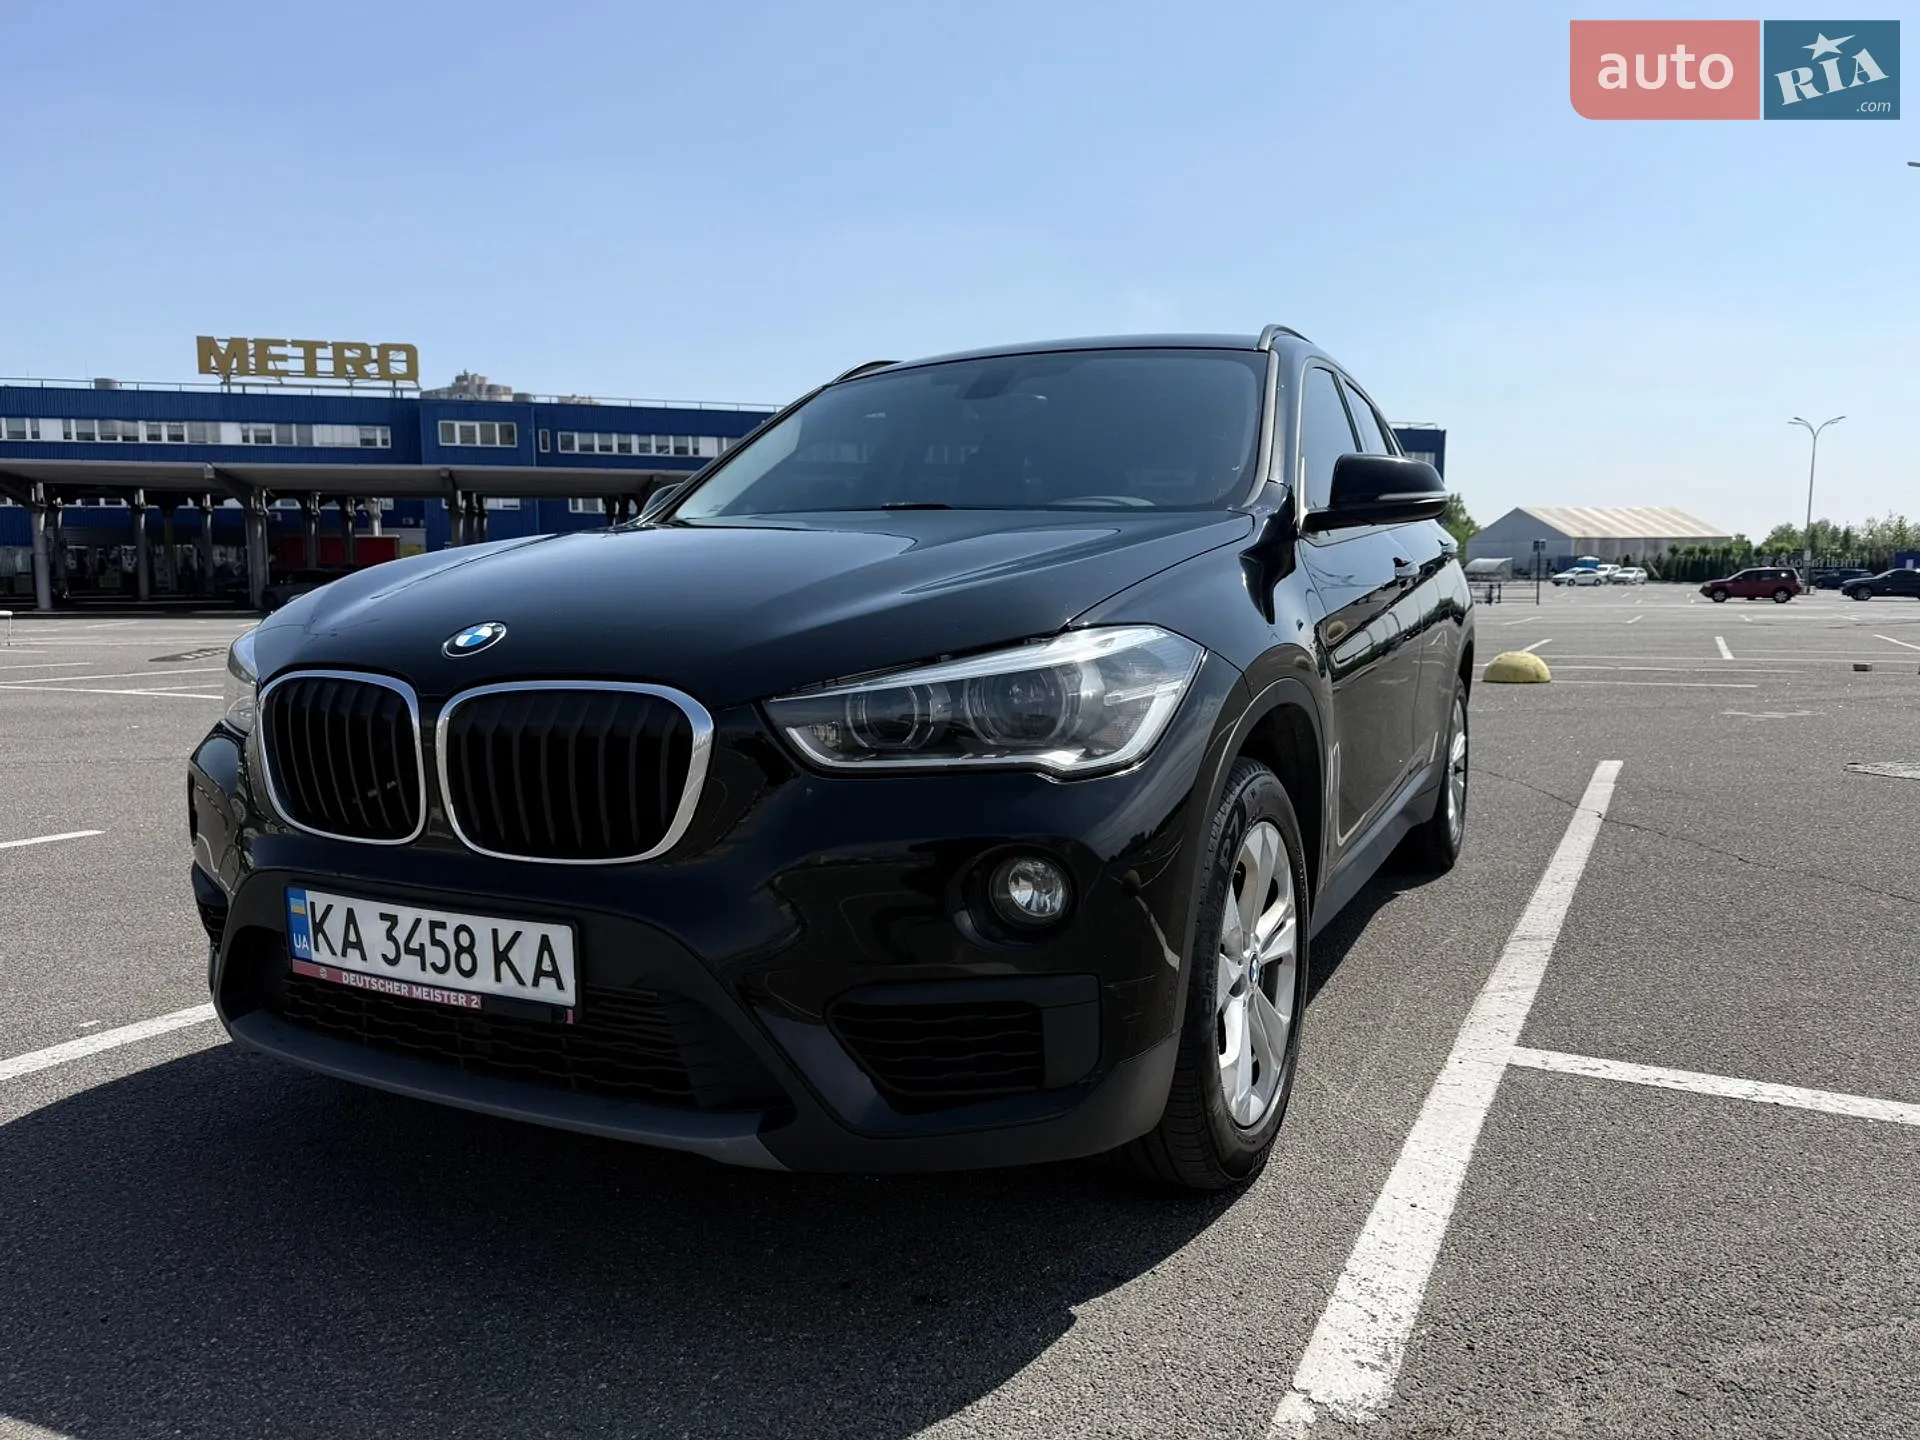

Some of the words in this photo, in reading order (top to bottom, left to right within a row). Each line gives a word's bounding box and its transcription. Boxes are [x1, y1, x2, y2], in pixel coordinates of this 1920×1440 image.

[195, 335, 420, 382] METRO
[293, 933, 309, 951] UA
[309, 900, 368, 962] KA
[378, 912, 478, 979] 3458
[491, 927, 566, 992] KA
[341, 972, 409, 997] DEUTSCHER
[412, 985, 467, 1008] MEISTER
